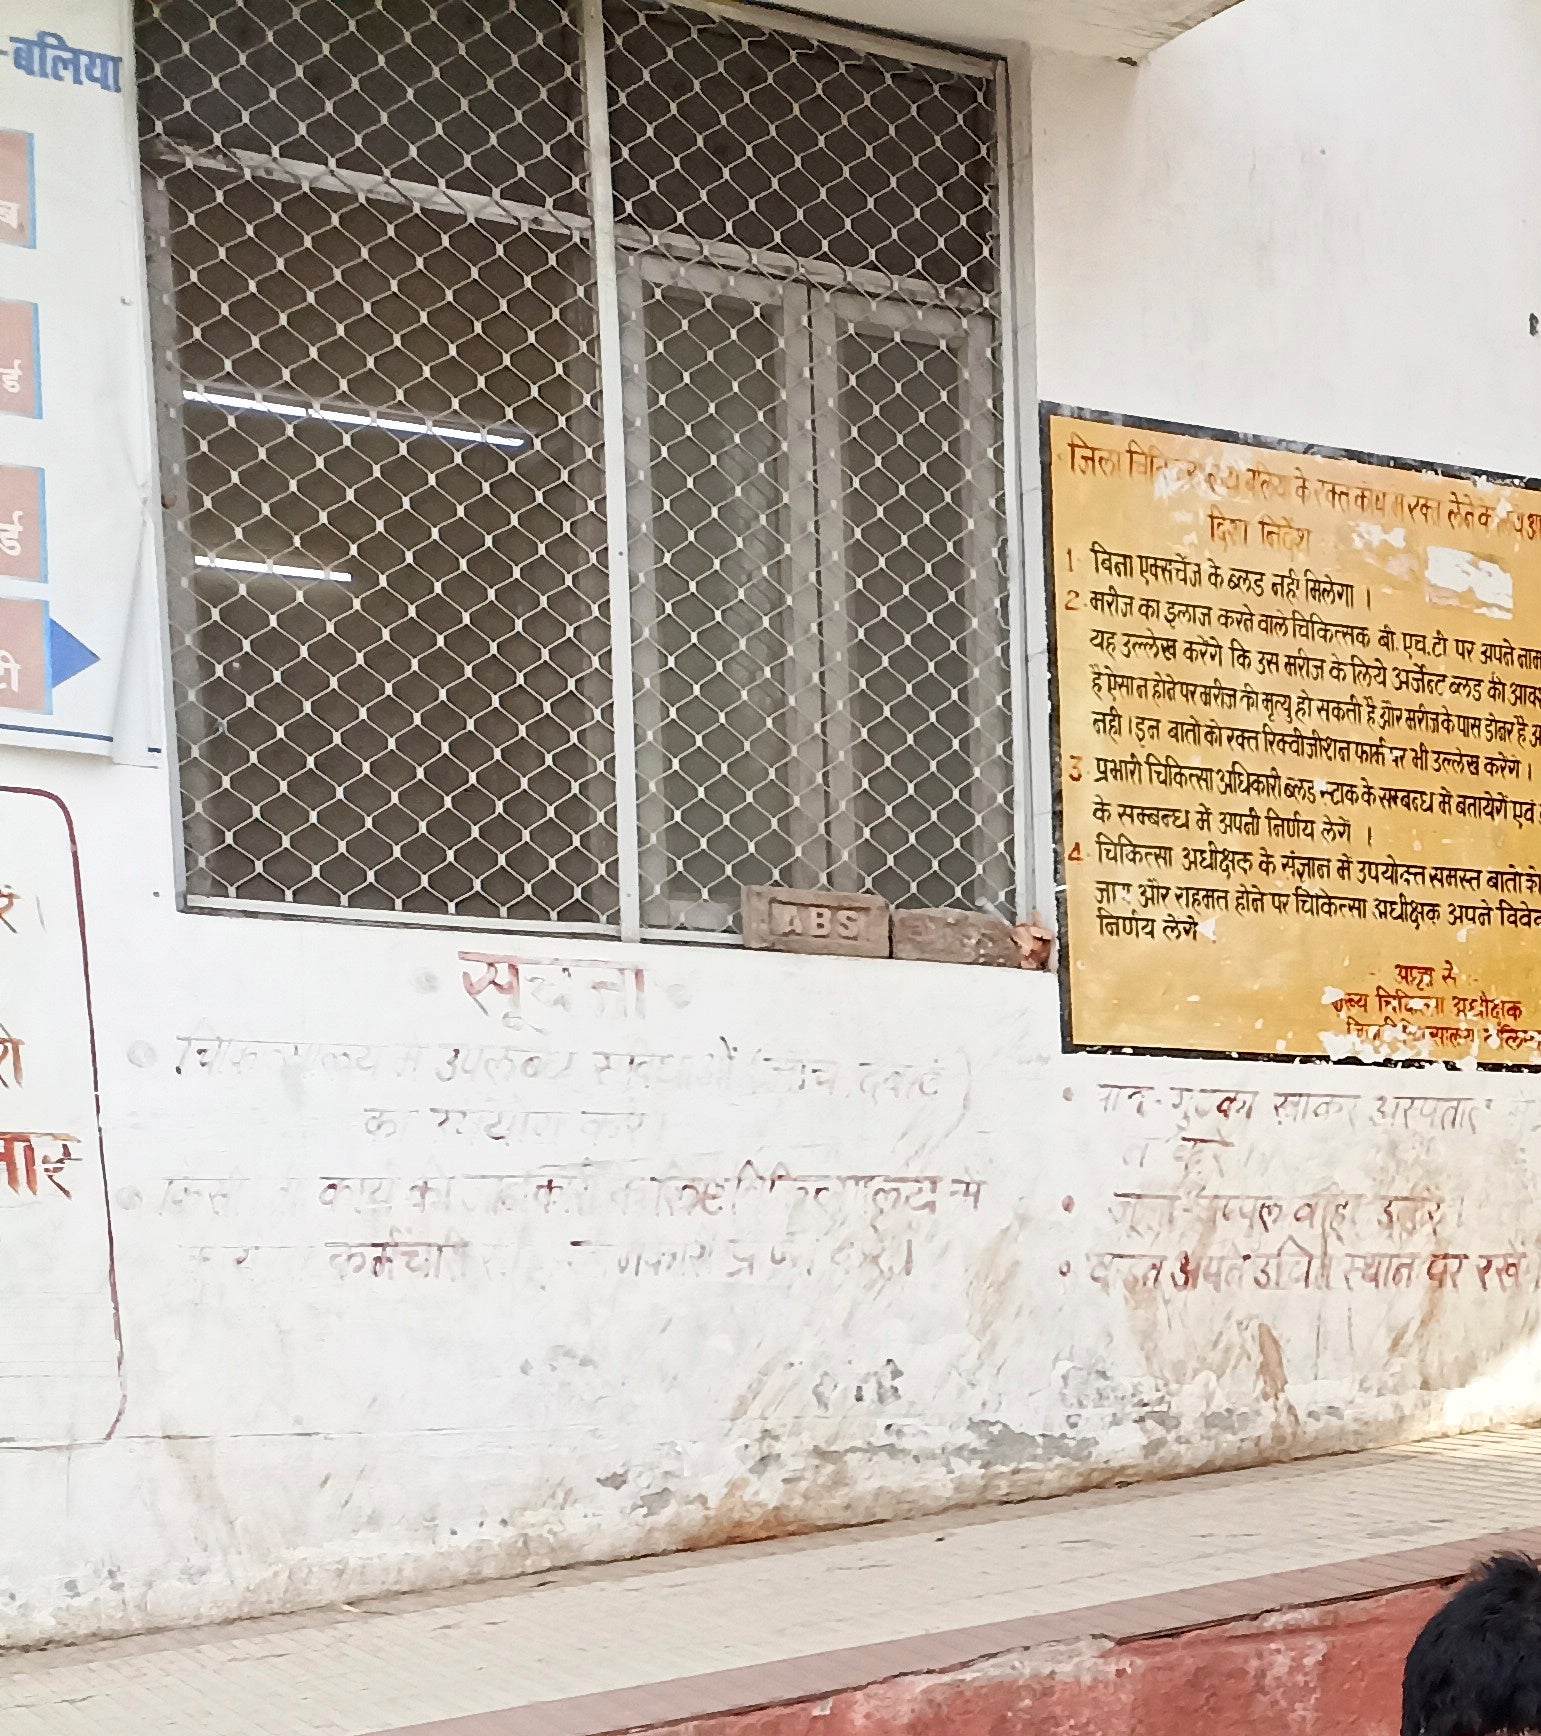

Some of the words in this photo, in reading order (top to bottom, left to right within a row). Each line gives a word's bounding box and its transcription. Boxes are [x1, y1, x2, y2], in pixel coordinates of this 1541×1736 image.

[1090, 540, 1134, 578] बिना
[1207, 558, 1224, 590] के
[1227, 567, 1265, 598] ब्लड
[1304, 569, 1354, 608] मिलेगा
[1089, 585, 1135, 618] मरीज
[1138, 598, 1159, 620] का
[1164, 601, 1212, 629] इलाज
[1217, 604, 1256, 634] करते
[1257, 609, 1289, 637] वाले
[1291, 609, 1371, 650] चिकित्सक
[1454, 639, 1476, 663] पर
[1480, 638, 1516, 668] अपने
[1089, 628, 1117, 659] यह
[1121, 628, 1177, 661] उल्लेख
[1229, 638, 1251, 669] कि
[1257, 650, 1279, 675] उस
[1284, 648, 1326, 680] मरीज
[1329, 653, 1347, 683] के
[1351, 654, 1387, 688] लिये
[1089, 664, 1103, 701] है
[1179, 682, 1197, 707] पर
[1200, 678, 1237, 711] मरीज
[1294, 689, 1312, 724] हो
[1316, 695, 1363, 725] सकती
[1364, 696, 1378, 732] है
[1379, 700, 1402, 731] और
[1404, 703, 1440, 734] मरीज
[1440, 705, 1455, 735] के
[1457, 714, 1481, 739] पास
[1484, 712, 1516, 743] डोनर
[1514, 714, 1528, 749] है
[1135, 716, 1162, 748] इन
[1204, 719, 1223, 747] को
[1226, 727, 1261, 754] रक्त
[1411, 742, 1429, 771] भी
[1431, 748, 1480, 776] उल्लेख
[1093, 753, 1142, 785] प्रभारी
[1145, 753, 1214, 793] चिकित्सा
[1216, 760, 1282, 800] अधिकारी
[1360, 777, 1377, 808] के
[1092, 795, 1112, 824] के
[1219, 807, 1262, 837] अपनी
[1264, 807, 1316, 841] निर्णय
[1095, 831, 1174, 869] चिकित्सा
[1181, 840, 1254, 880] अधीक्षक
[1258, 847, 1277, 877] के
[1429, 865, 1483, 892] समस्त
[1096, 906, 1156, 940] निर्णय
[1138, 877, 1171, 910] और
[1234, 883, 1265, 917] होने
[1269, 893, 1291, 915] पर
[1373, 892, 1442, 931] अधीक्षक
[1447, 899, 1494, 927] अपने
